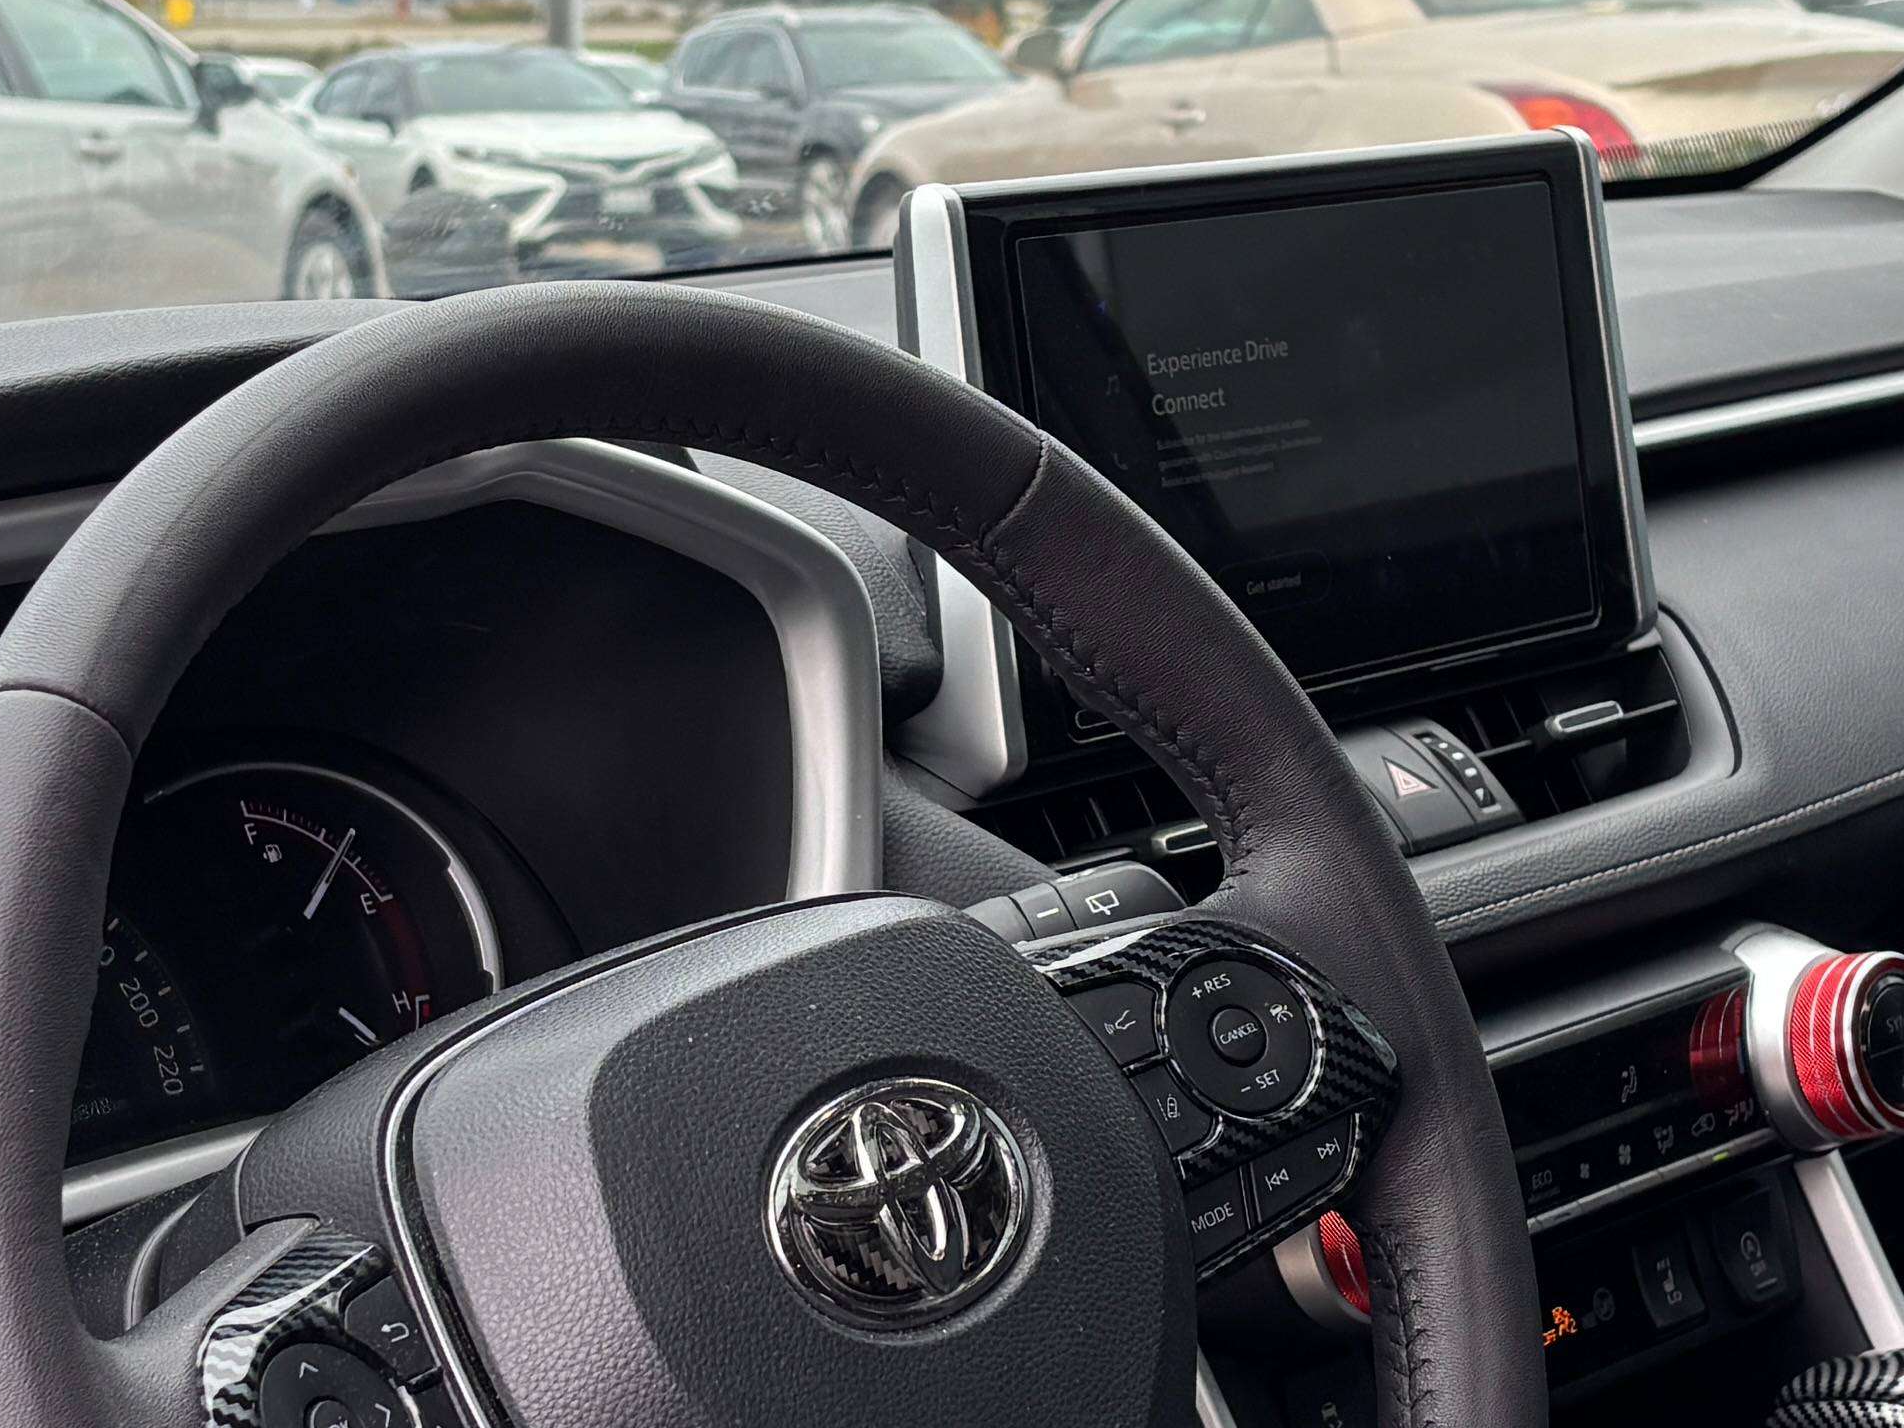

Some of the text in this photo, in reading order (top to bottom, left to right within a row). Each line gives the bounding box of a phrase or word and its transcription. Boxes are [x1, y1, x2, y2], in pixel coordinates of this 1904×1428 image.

[1145, 336, 1290, 378] Experience Drive
[1151, 387, 1227, 416] Connect
[243, 822, 258, 846] F
[359, 892, 378, 916] E
[1204, 972, 1233, 994] RES
[118, 976, 160, 1029] 200
[391, 990, 412, 1016] H
[152, 1044, 184, 1096] 220
[1255, 1068, 1283, 1090] SET
[1190, 1201, 1235, 1234] MODE
